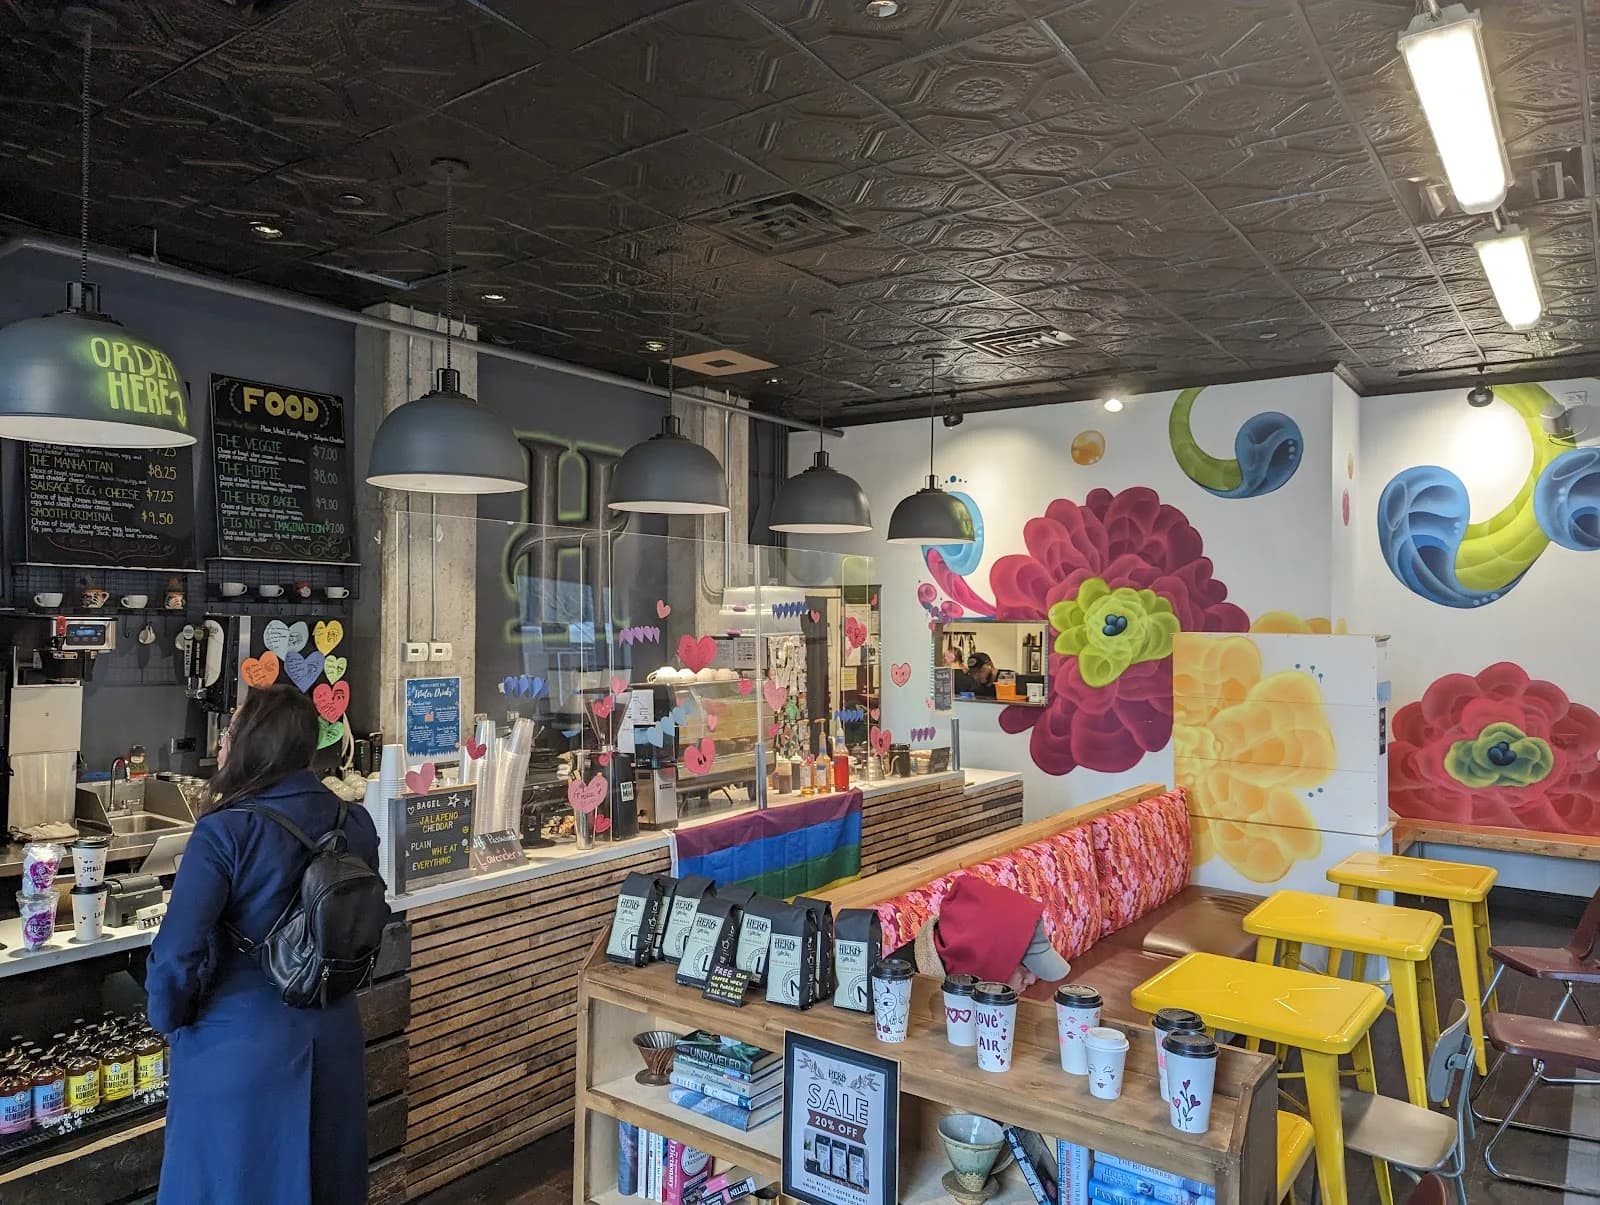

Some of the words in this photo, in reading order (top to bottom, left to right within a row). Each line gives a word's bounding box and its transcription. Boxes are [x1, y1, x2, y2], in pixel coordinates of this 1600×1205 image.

[90, 337, 177, 383] ORDER
[107, 371, 173, 416] HERE
[243, 387, 319, 422] FOOD
[216, 432, 241, 449] THE
[244, 437, 282, 454] VEGGIE
[29, 453, 50, 467] THE
[54, 456, 114, 473] MANHATTAN
[218, 460, 243, 476] THE
[246, 464, 281, 481] HIPPIE
[148, 462, 177, 480] $8.25
[105, 487, 142, 501] CHEESE
[221, 489, 242, 504] THE
[246, 492, 271, 506] HERO
[30, 507, 68, 520] SMOOTH
[70, 510, 119, 523] CRIMINAL
[142, 510, 174, 525] $9.50
[416, 799, 441, 810] BAGEL
[420, 811, 459, 826] JALAPENO
[422, 820, 454, 834] CHEDDAR
[410, 839, 432, 851] PLAIN
[412, 856, 452, 871] EVERYTHING
[620, 898, 639, 910] HERO
[696, 916, 717, 930] HERO
[746, 918, 769, 932] HERO
[774, 938, 797, 951] HERO
[839, 944, 862, 957] HERO
[714, 966, 733, 978] FREE
[978, 1036, 1001, 1053] AIR
[690, 1047, 741, 1070] UNRAVELED
[828, 1068, 847, 1083] HERO
[806, 1083, 869, 1126] SALE
[815, 1115, 836, 1131] 20%
[838, 1123, 858, 1138] OFF
